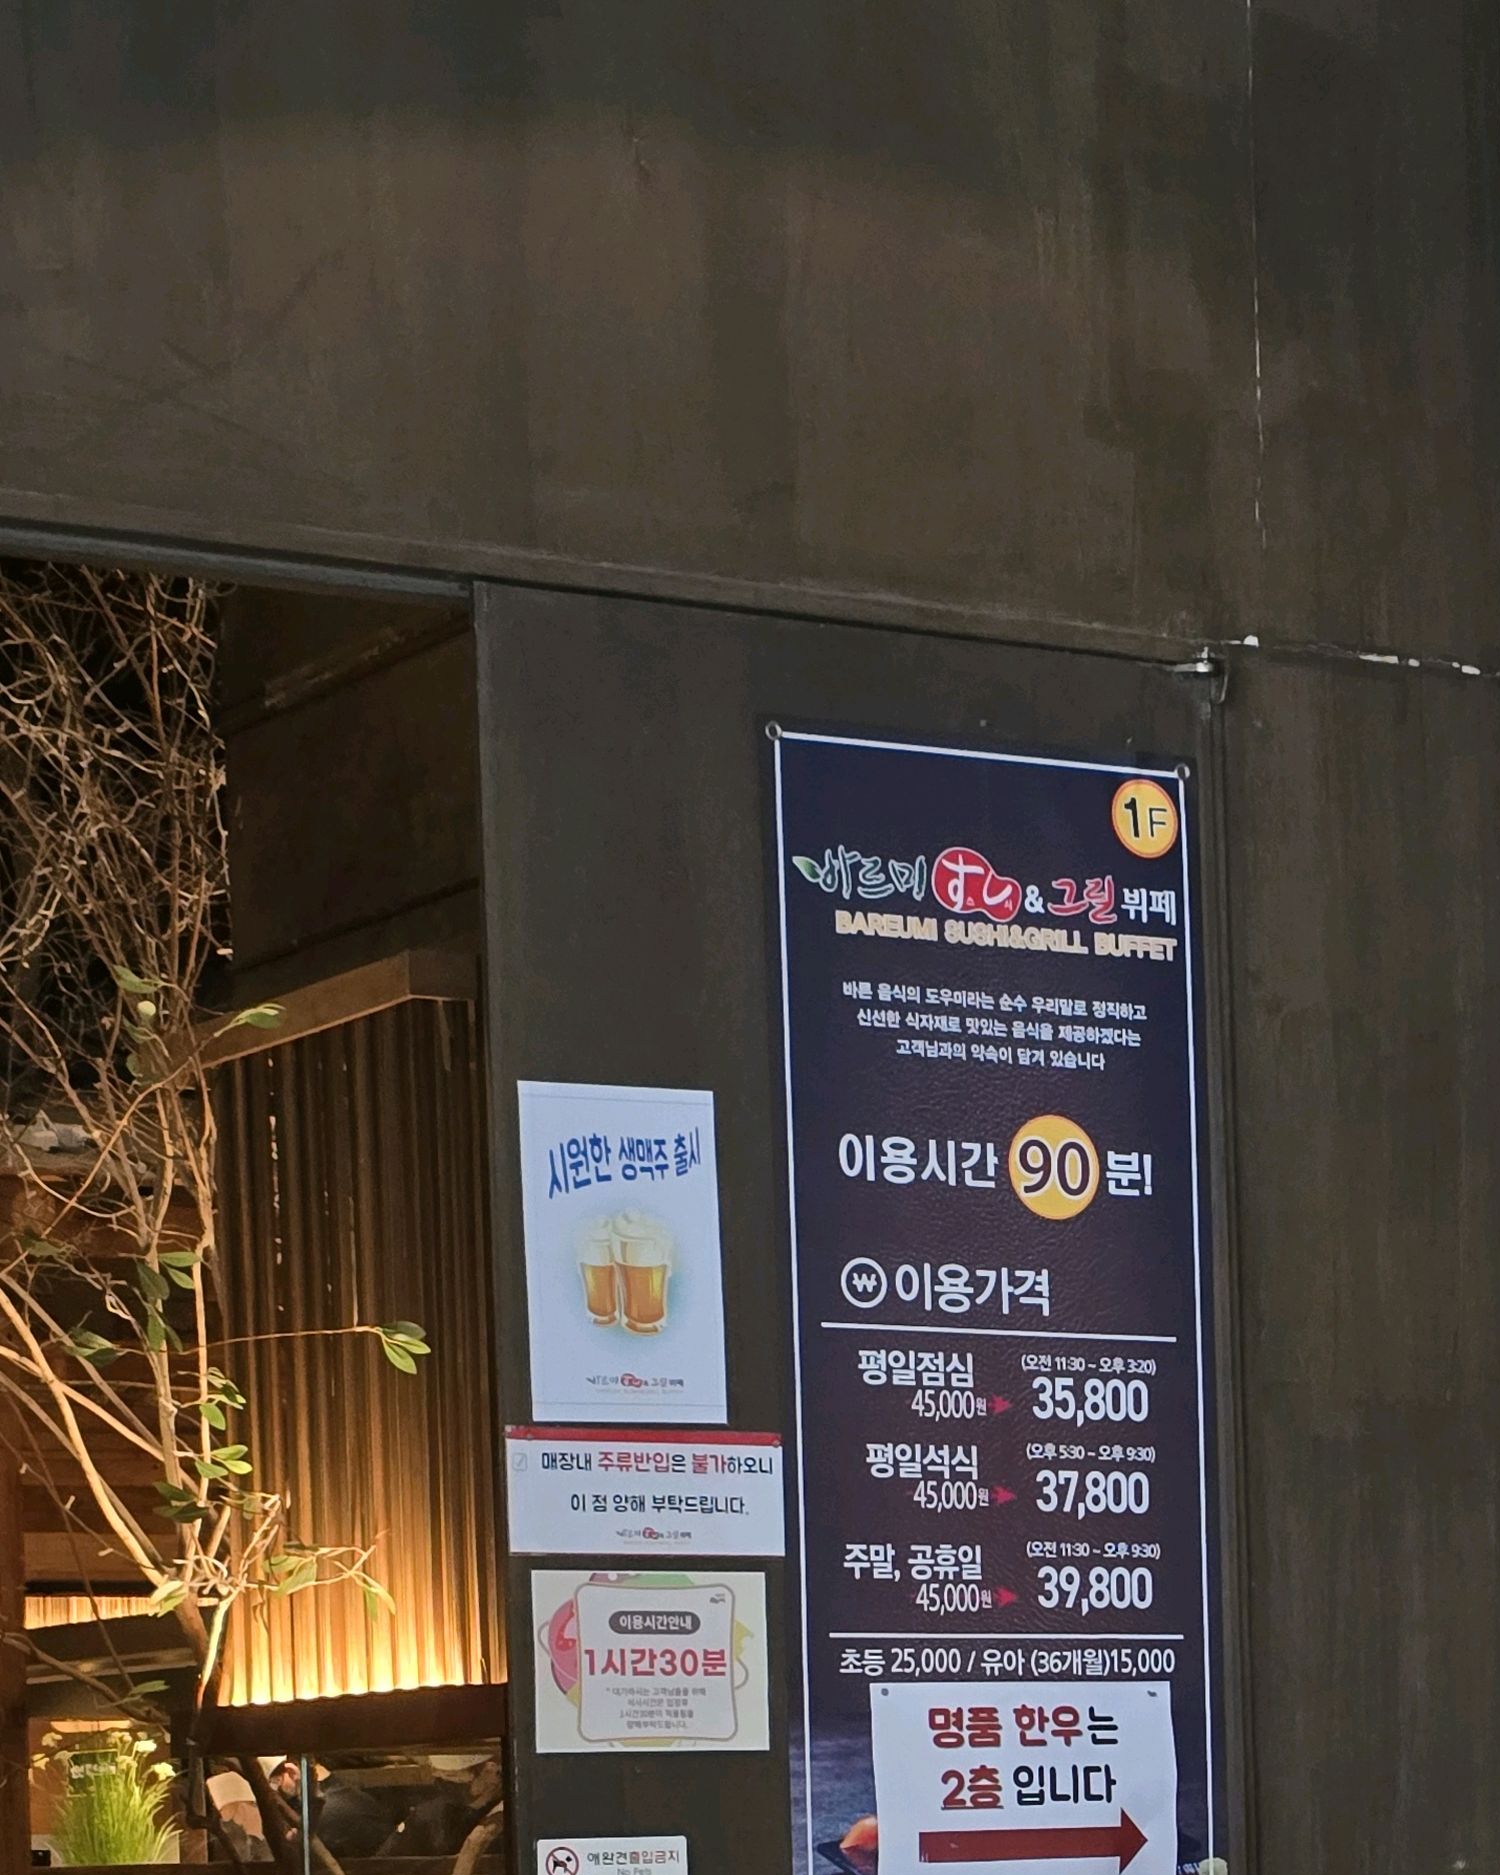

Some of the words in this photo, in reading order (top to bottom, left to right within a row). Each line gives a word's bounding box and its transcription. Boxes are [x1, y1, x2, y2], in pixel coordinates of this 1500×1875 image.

[1124, 797, 1167, 838] 1F
[793, 846, 926, 900] 바르미
[1024, 886, 1044, 913] &
[1048, 876, 1116, 924] 그릴
[1121, 888, 1176, 925] 뷔페
[835, 910, 938, 940] BAREUMI
[944, 920, 1089, 955] SUSHI&GRILL
[1094, 931, 1178, 961] BUFFET
[843, 981, 873, 1000] 바른
[878, 983, 920, 1003] 음식의
[925, 988, 994, 1010] 도우미라는
[1000, 993, 1027, 1012] 순수
[1032, 996, 1088, 1016] 우리말로
[1093, 1001, 1147, 1020] 정직하고
[857, 1008, 900, 1028] 신선한
[905, 1012, 961, 1032] 식자재로
[966, 1018, 1007, 1037] 맛있는
[1012, 1021, 1053, 1041] 음식을
[1058, 1025, 1141, 1047] 제공하겠다는
[896, 1039, 966, 1060] 고객님과의
[971, 1043, 1012, 1064] 약속이
[1017, 1048, 1044, 1066] 담겨
[1050, 1050, 1105, 1071] 있습니다
[549, 1133, 611, 1199] 시원한
[619, 1136, 669, 1181] 생맥주
[674, 1126, 701, 1176] 출시
[838, 1133, 999, 1188] 이용시간
[1018, 1135, 1091, 1197] 90
[1106, 1151, 1152, 1196] 분!
[895, 1262, 1049, 1316] 이용가격
[858, 1349, 974, 1387] 평일점심
[1021, 1353, 1052, 1371] (오전
[1055, 1357, 1085, 1371] 11:30
[1099, 1357, 1125, 1374] 오후
[1127, 1359, 1157, 1375] 3:20)
[1032, 1376, 1148, 1428] 35,800
[541, 1452, 591, 1472] 매장내
[598, 1452, 686, 1473] 주류반입은
[692, 1454, 772, 1474] 불가하오니
[866, 1442, 978, 1480] 평일석식
[1026, 1443, 1057, 1460] (오후
[1059, 1445, 1085, 1459] 5:30
[1098, 1445, 1126, 1461] 오후
[1127, 1446, 1155, 1463] 9:30)
[570, 1494, 586, 1512] 이
[592, 1495, 607, 1512] 점
[612, 1495, 645, 1513] 양해
[652, 1496, 749, 1515] 부탁드립니다.
[1035, 1469, 1150, 1520] 37,800
[843, 1543, 901, 1582] 주말,
[908, 1544, 983, 1581] 공휴일
[1027, 1540, 1057, 1558] (오전
[1060, 1543, 1089, 1557] 11:30
[1103, 1542, 1129, 1559] 오후
[1131, 1543, 1160, 1560] 9:30)
[1038, 1565, 1153, 1616] 39,800
[619, 1615, 692, 1630] 이용시간안내
[584, 1649, 726, 1677] 1시간30분
[839, 1649, 885, 1675] 초등
[891, 1648, 961, 1676] 25,000
[981, 1650, 1025, 1675] 유아
[928, 1706, 1002, 1749] 명품
[1012, 1704, 1118, 1748] 한우는
[941, 1764, 1003, 1808] 2층
[1014, 1764, 1117, 1806] 입니다
[587, 1851, 680, 1865] 애완견출입금지
